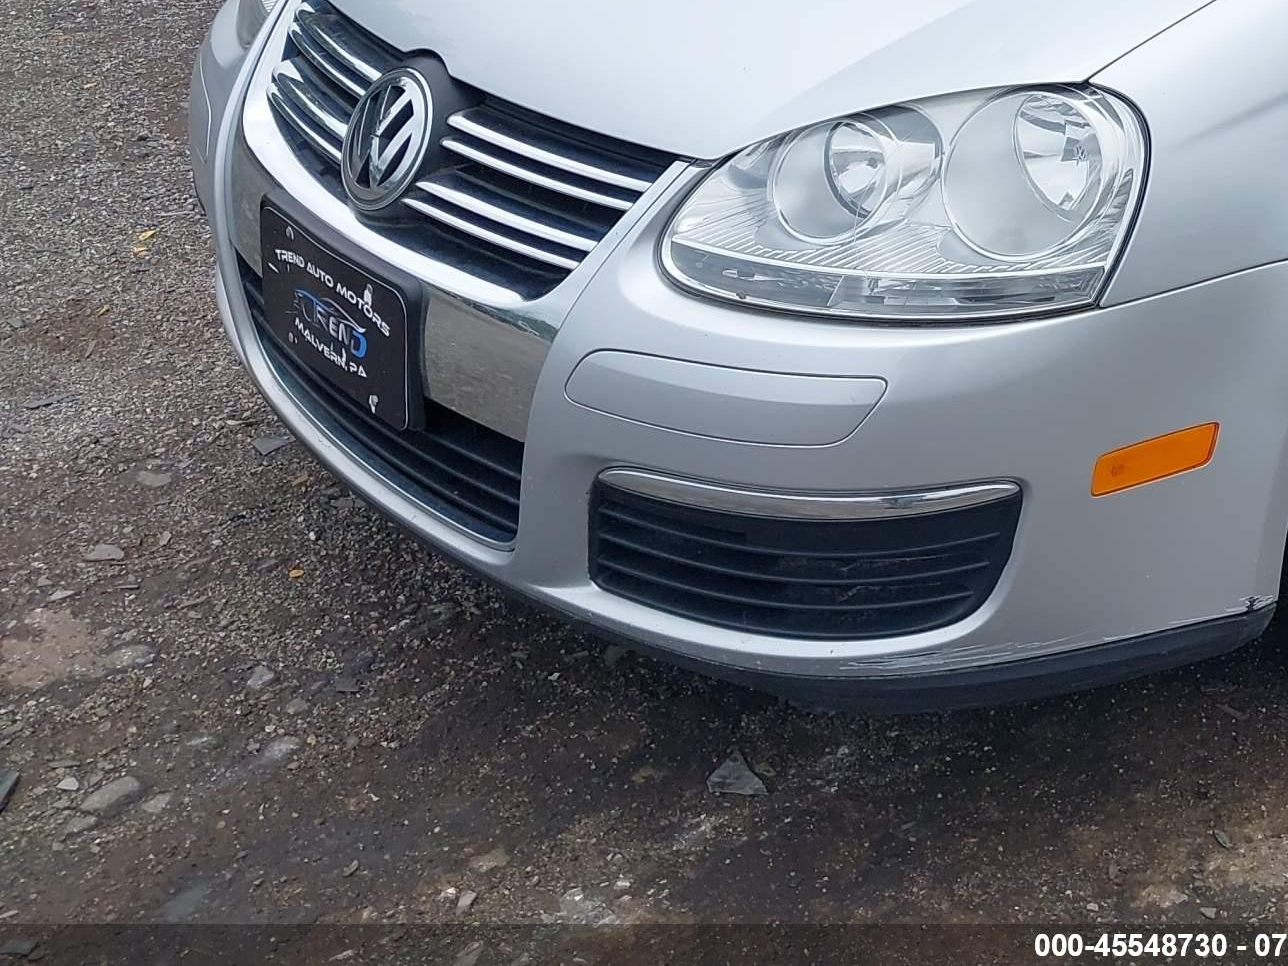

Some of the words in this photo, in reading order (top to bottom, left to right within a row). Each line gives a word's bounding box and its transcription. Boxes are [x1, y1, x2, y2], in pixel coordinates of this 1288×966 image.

[275, 249, 305, 268] TREND
[307, 262, 334, 288] AUTO
[336, 283, 391, 337] MOTORS
[349, 362, 367, 377] PA
